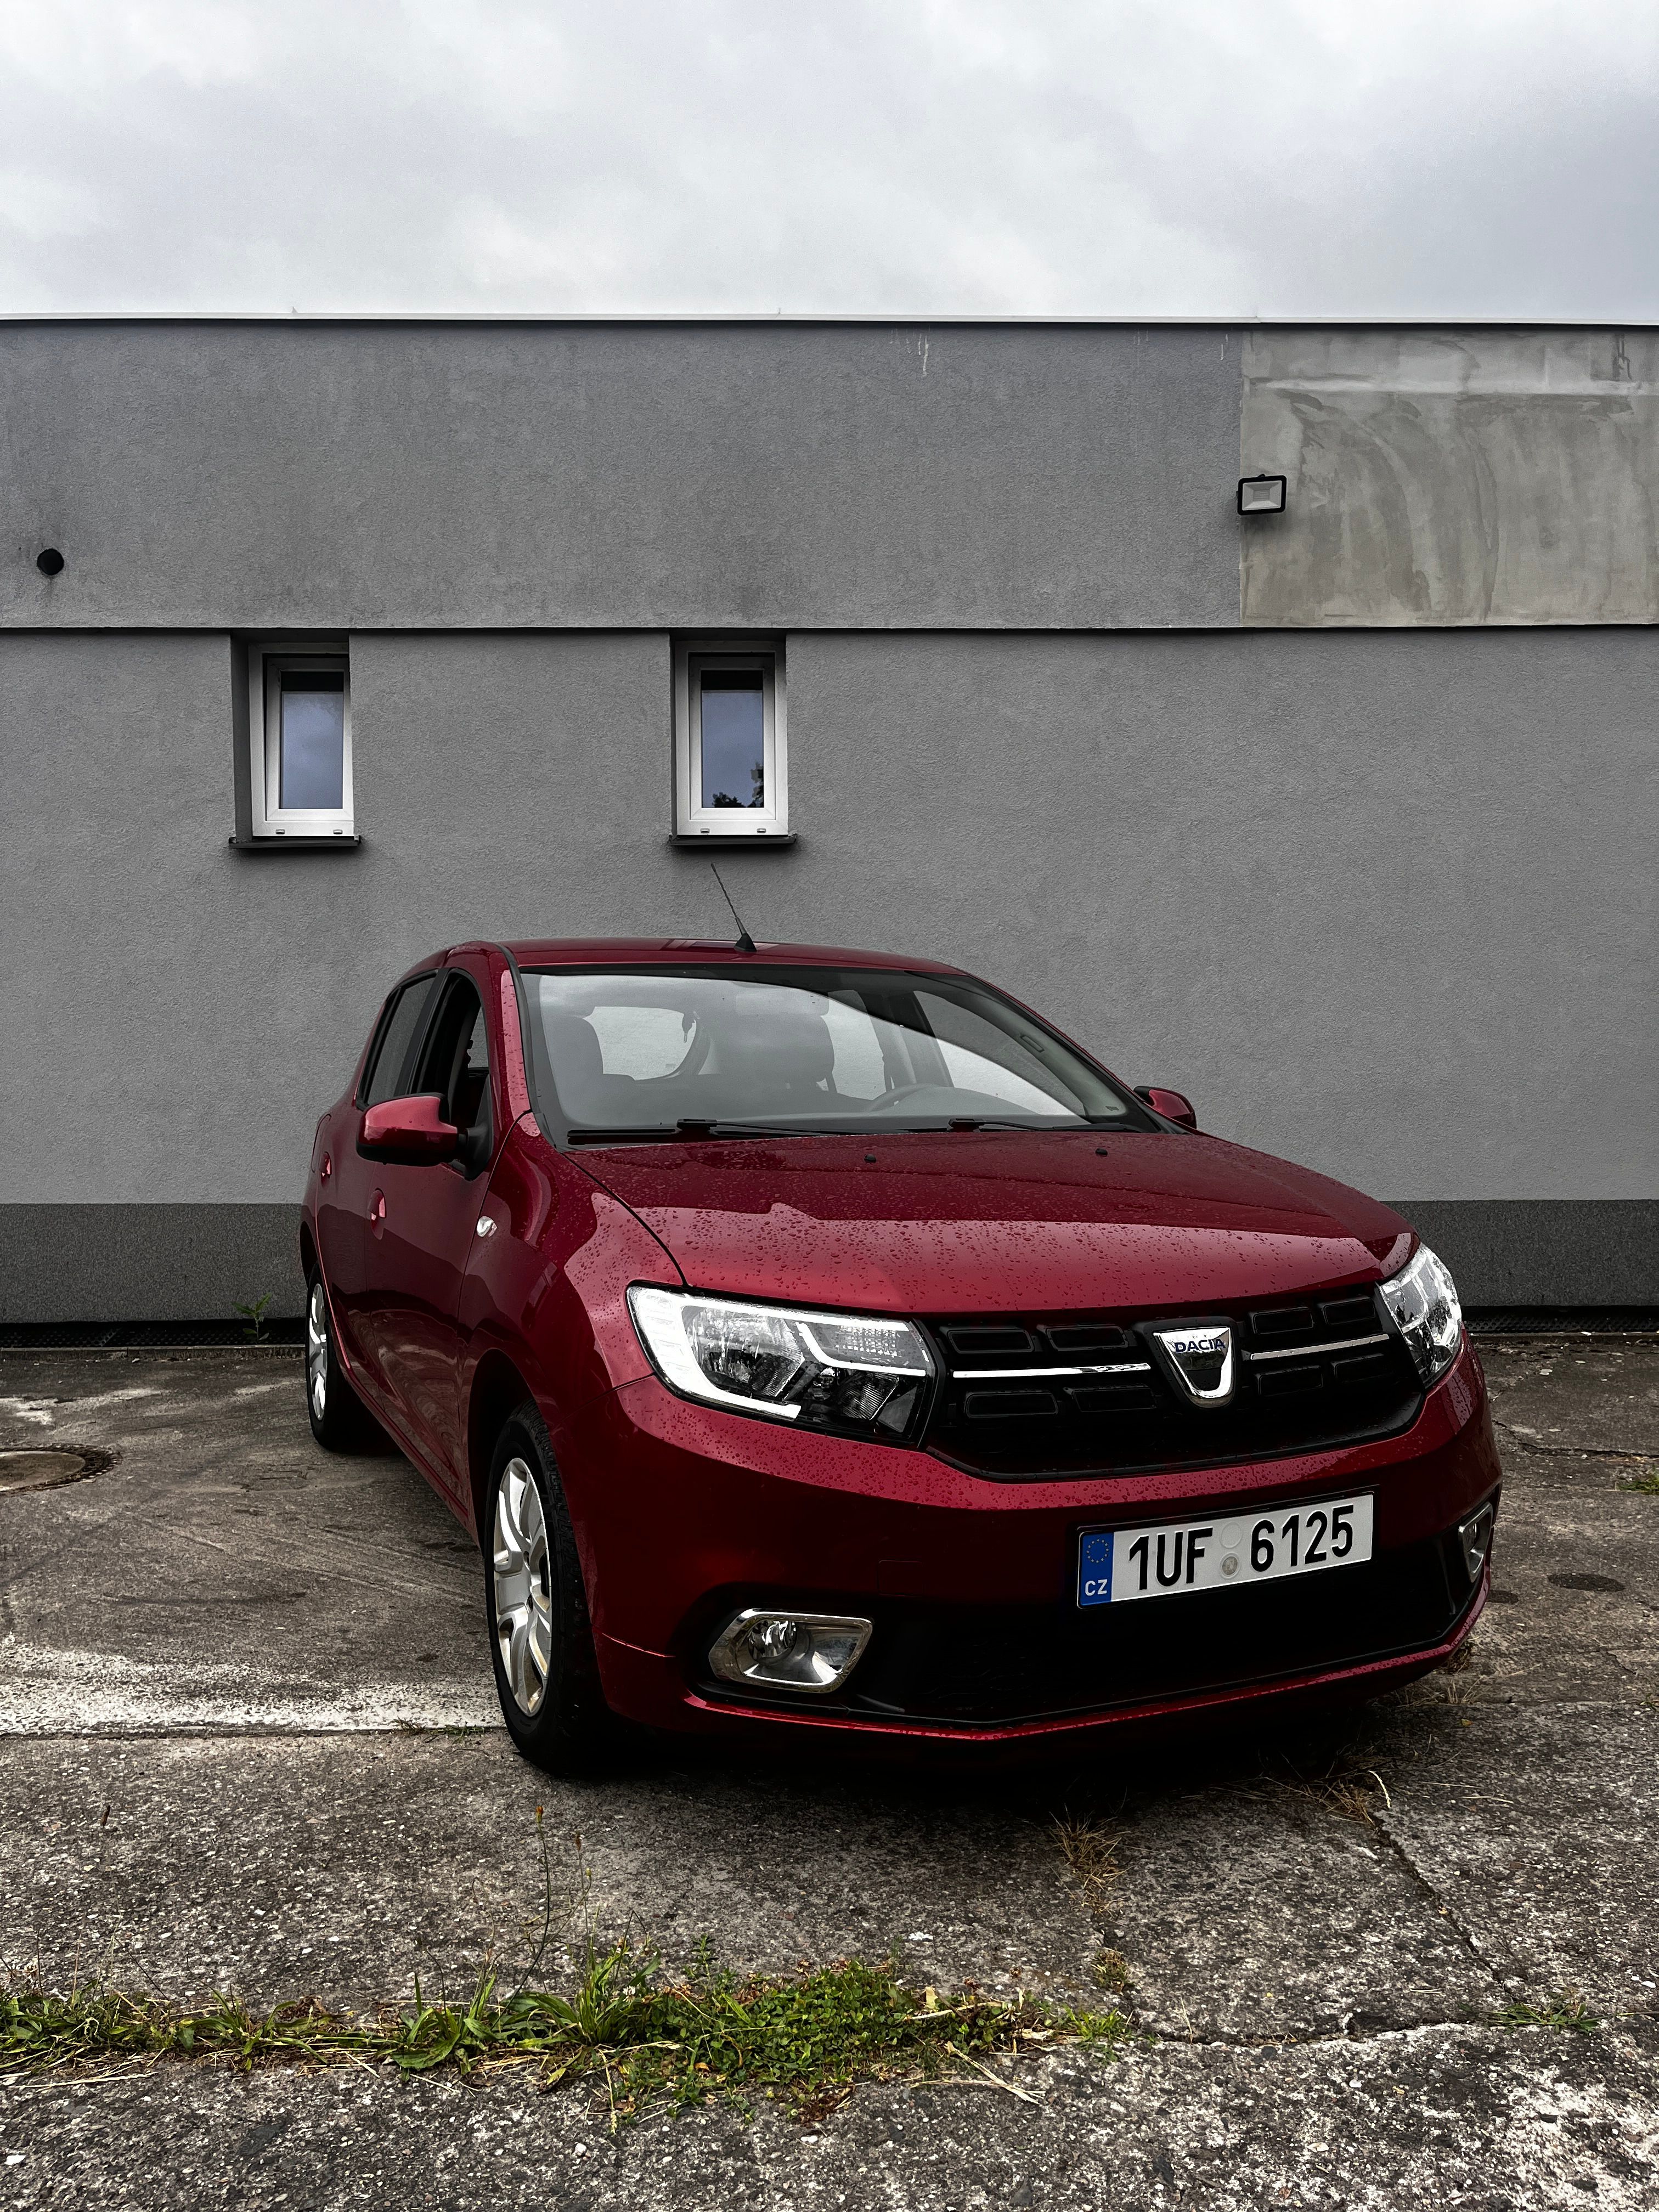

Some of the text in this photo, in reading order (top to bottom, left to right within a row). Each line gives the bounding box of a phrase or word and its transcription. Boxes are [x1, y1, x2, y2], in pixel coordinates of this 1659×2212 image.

[1174, 1339, 1226, 1352] DACIA
[1129, 1504, 1354, 1590] 1UF 6125
[1085, 1579, 1108, 1596] CZ
